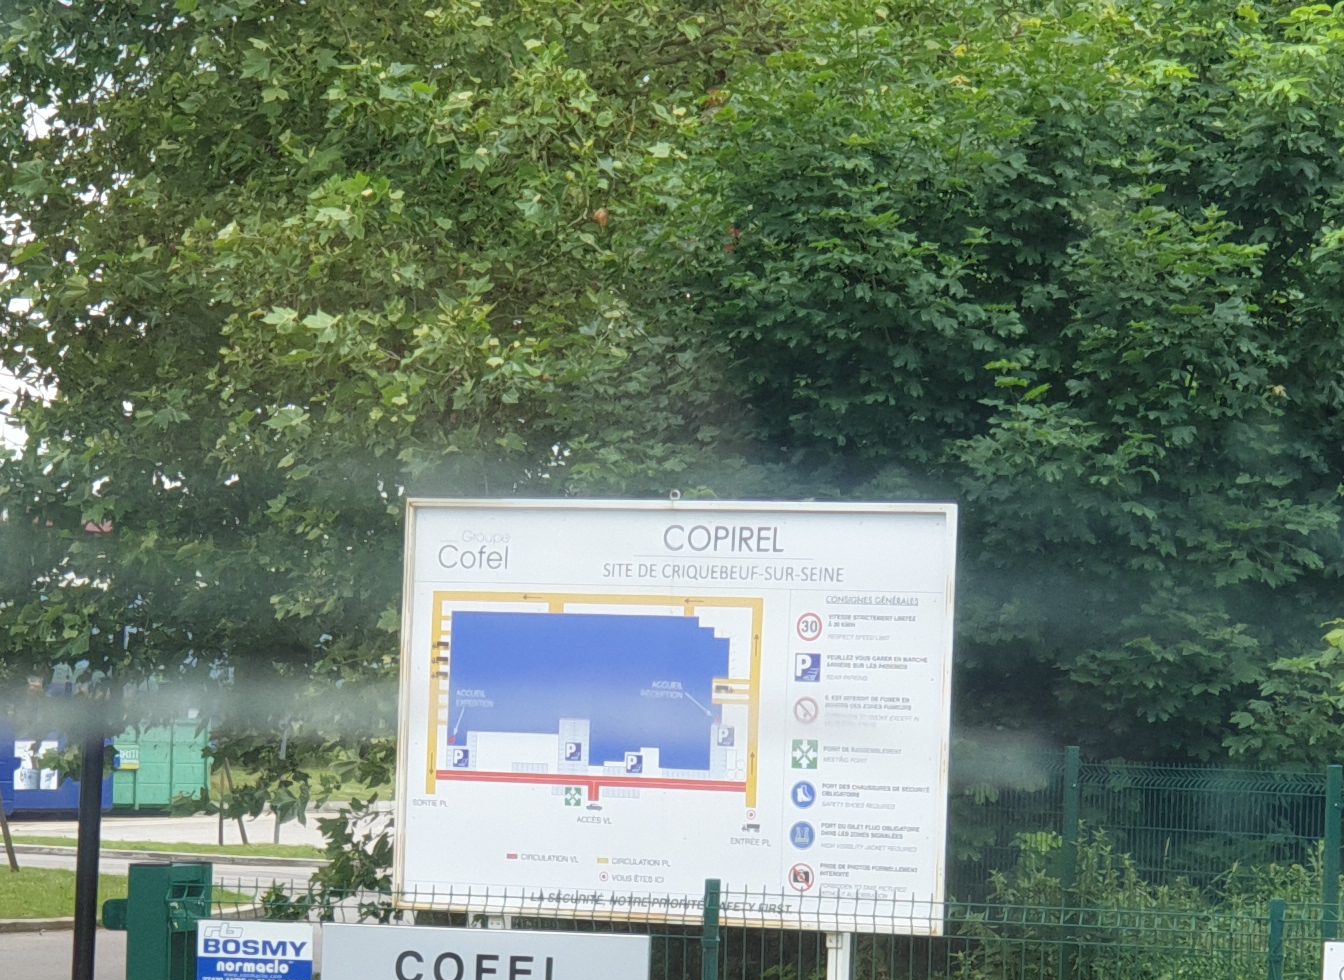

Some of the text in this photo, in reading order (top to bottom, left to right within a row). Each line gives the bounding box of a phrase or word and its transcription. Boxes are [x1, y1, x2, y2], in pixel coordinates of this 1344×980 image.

[461, 530, 511, 544] Groupe
[663, 524, 784, 554] COPIREL
[437, 543, 509, 571] Cofel
[603, 563, 845, 583] SITE DE CRIQUEBEUF-SUR-SEINE
[826, 594, 918, 607] CONSIGNES GÉNÉRALES
[801, 620, 818, 633] 30
[412, 798, 448, 808] SORTIE PL
[577, 814, 612, 825] ACCÈS VL
[730, 836, 771, 847] ENTRÉE PL
[520, 853, 568, 863] CIRCULATION
[612, 857, 671, 867] CIRCULATION PL
[612, 874, 633, 883] VOUS
[654, 875, 664, 883] ICI
[203, 938, 307, 957] BOSMY
[216, 960, 289, 974] normaclo
